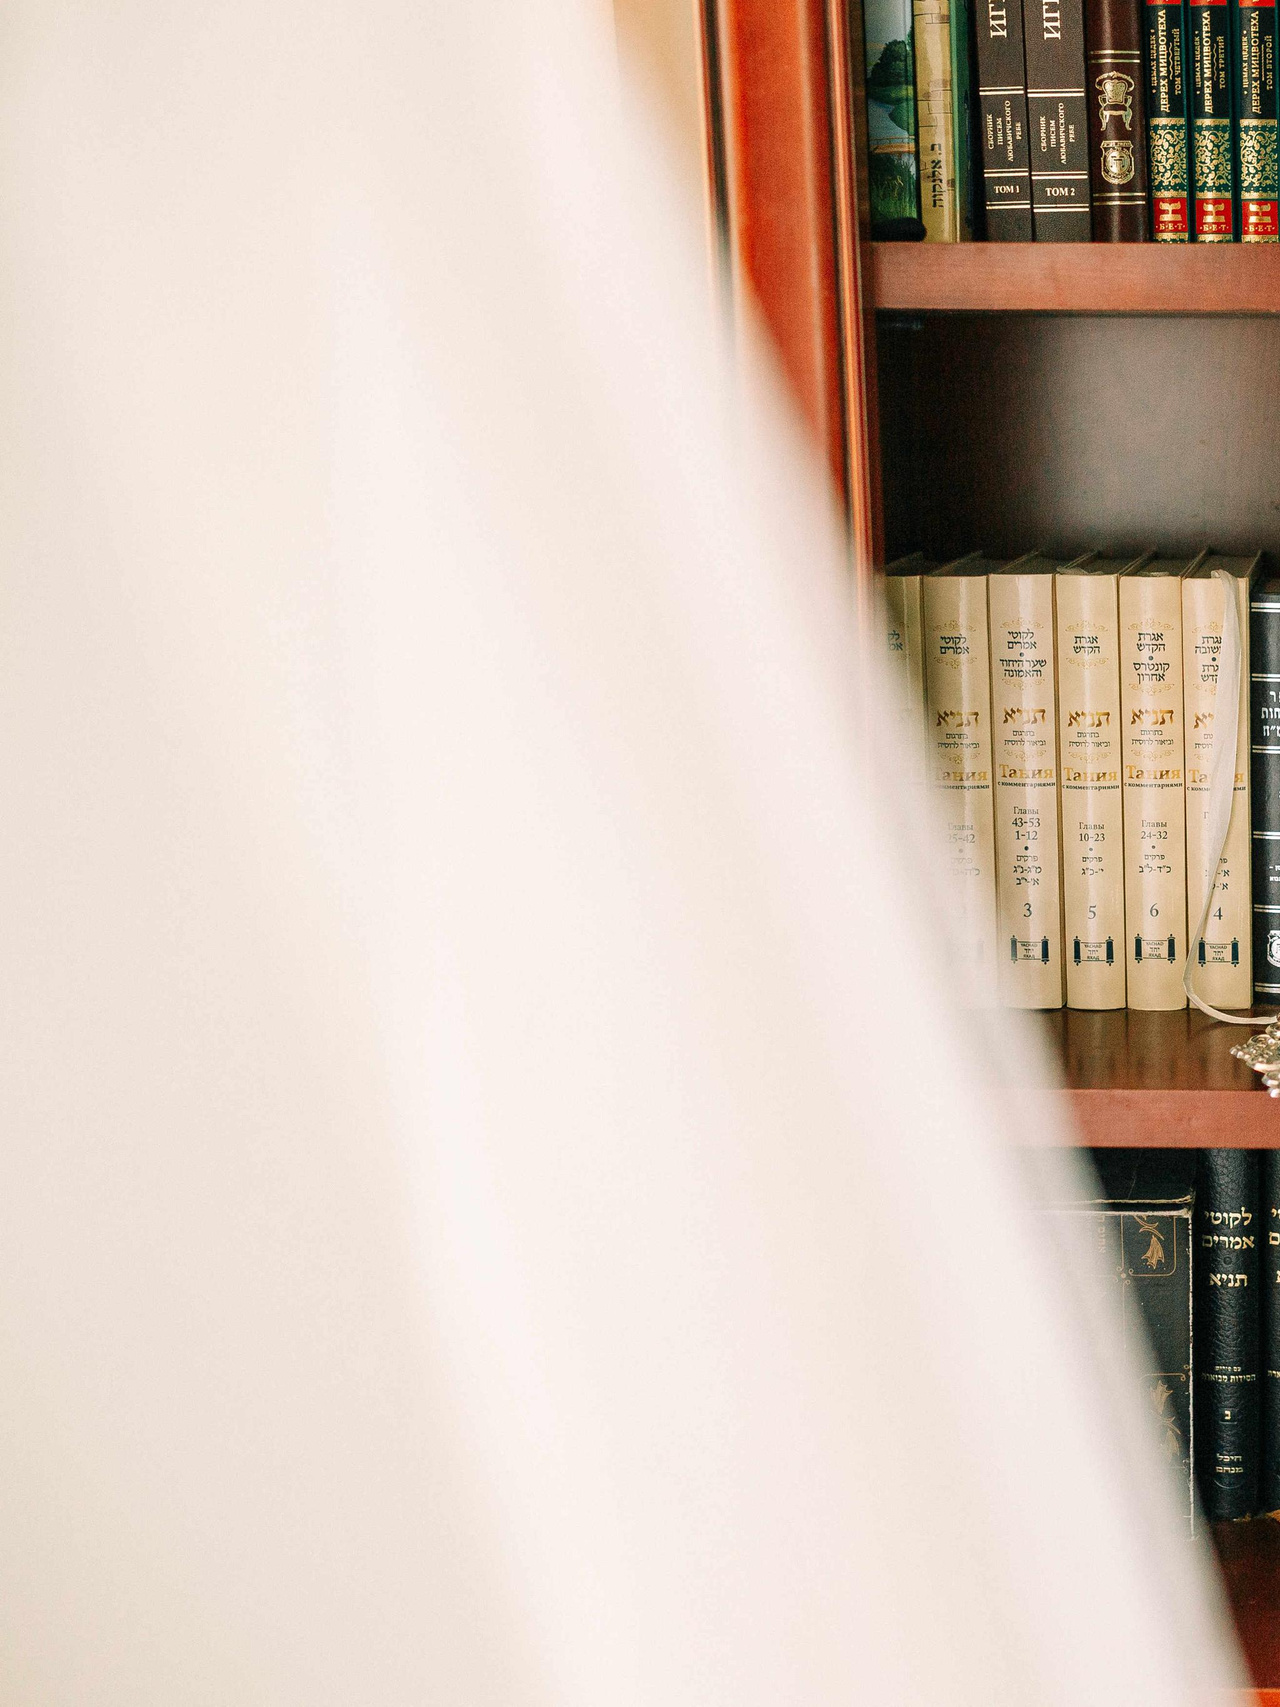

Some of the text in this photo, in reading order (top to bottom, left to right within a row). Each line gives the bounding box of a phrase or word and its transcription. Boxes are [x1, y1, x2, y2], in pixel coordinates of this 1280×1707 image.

[1172, 29, 1180, 75] ЧЕТВЕРТЫЙ
[1264, 36, 1272, 69] ВТОРОЙ
[1158, 10, 1170, 112] ДЕРЕХ МИЦВОТЕХА
[1202, 11, 1213, 113] ДЕРЕХ МИЦВОТЕХА
[1251, 11, 1261, 113] ДЕРЕХ МИЦВОТЕХА
[1045, 188, 1067, 196] ТОМ
[1008, 628, 1034, 639] לקוטי
[1074, 634, 1098, 644] אגרת
[1138, 631, 1163, 641] אגרת
[939, 634, 966, 647] לקוטי
[1007, 641, 1037, 649] אמרים
[939, 645, 969, 656] אמרים
[1073, 646, 1100, 654] הקדש
[1136, 643, 1165, 653] הקדש
[1000, 659, 1047, 668] שער היחוד
[1133, 662, 1170, 674] קונטרס
[1004, 669, 1042, 678] והאמונה
[1137, 673, 1165, 684] אחרון
[1003, 708, 1046, 724] תניא
[1068, 711, 1110, 727] תניא
[1131, 707, 1174, 725] תניא
[1000, 764, 1053, 778] Тания
[1064, 767, 1116, 781] Тания
[1126, 765, 1180, 779] Тания
[1013, 806, 1038, 814] Главы
[1012, 817, 1040, 827] 43-53
[1079, 822, 1104, 830] Главы
[1015, 830, 1037, 840] 1-12
[1079, 833, 1105, 841] 10-23
[1141, 831, 1167, 839] 24-32
[1023, 903, 1032, 917] 3
[1088, 905, 1096, 919] 5
[1150, 903, 1159, 917] 6
[1214, 907, 1223, 920] 4
[1204, 1207, 1252, 1229] לקוטי
[1202, 1233, 1254, 1249] אמרים
[1211, 1272, 1247, 1287] תניא
[1225, 1410, 1231, 1419] ב
